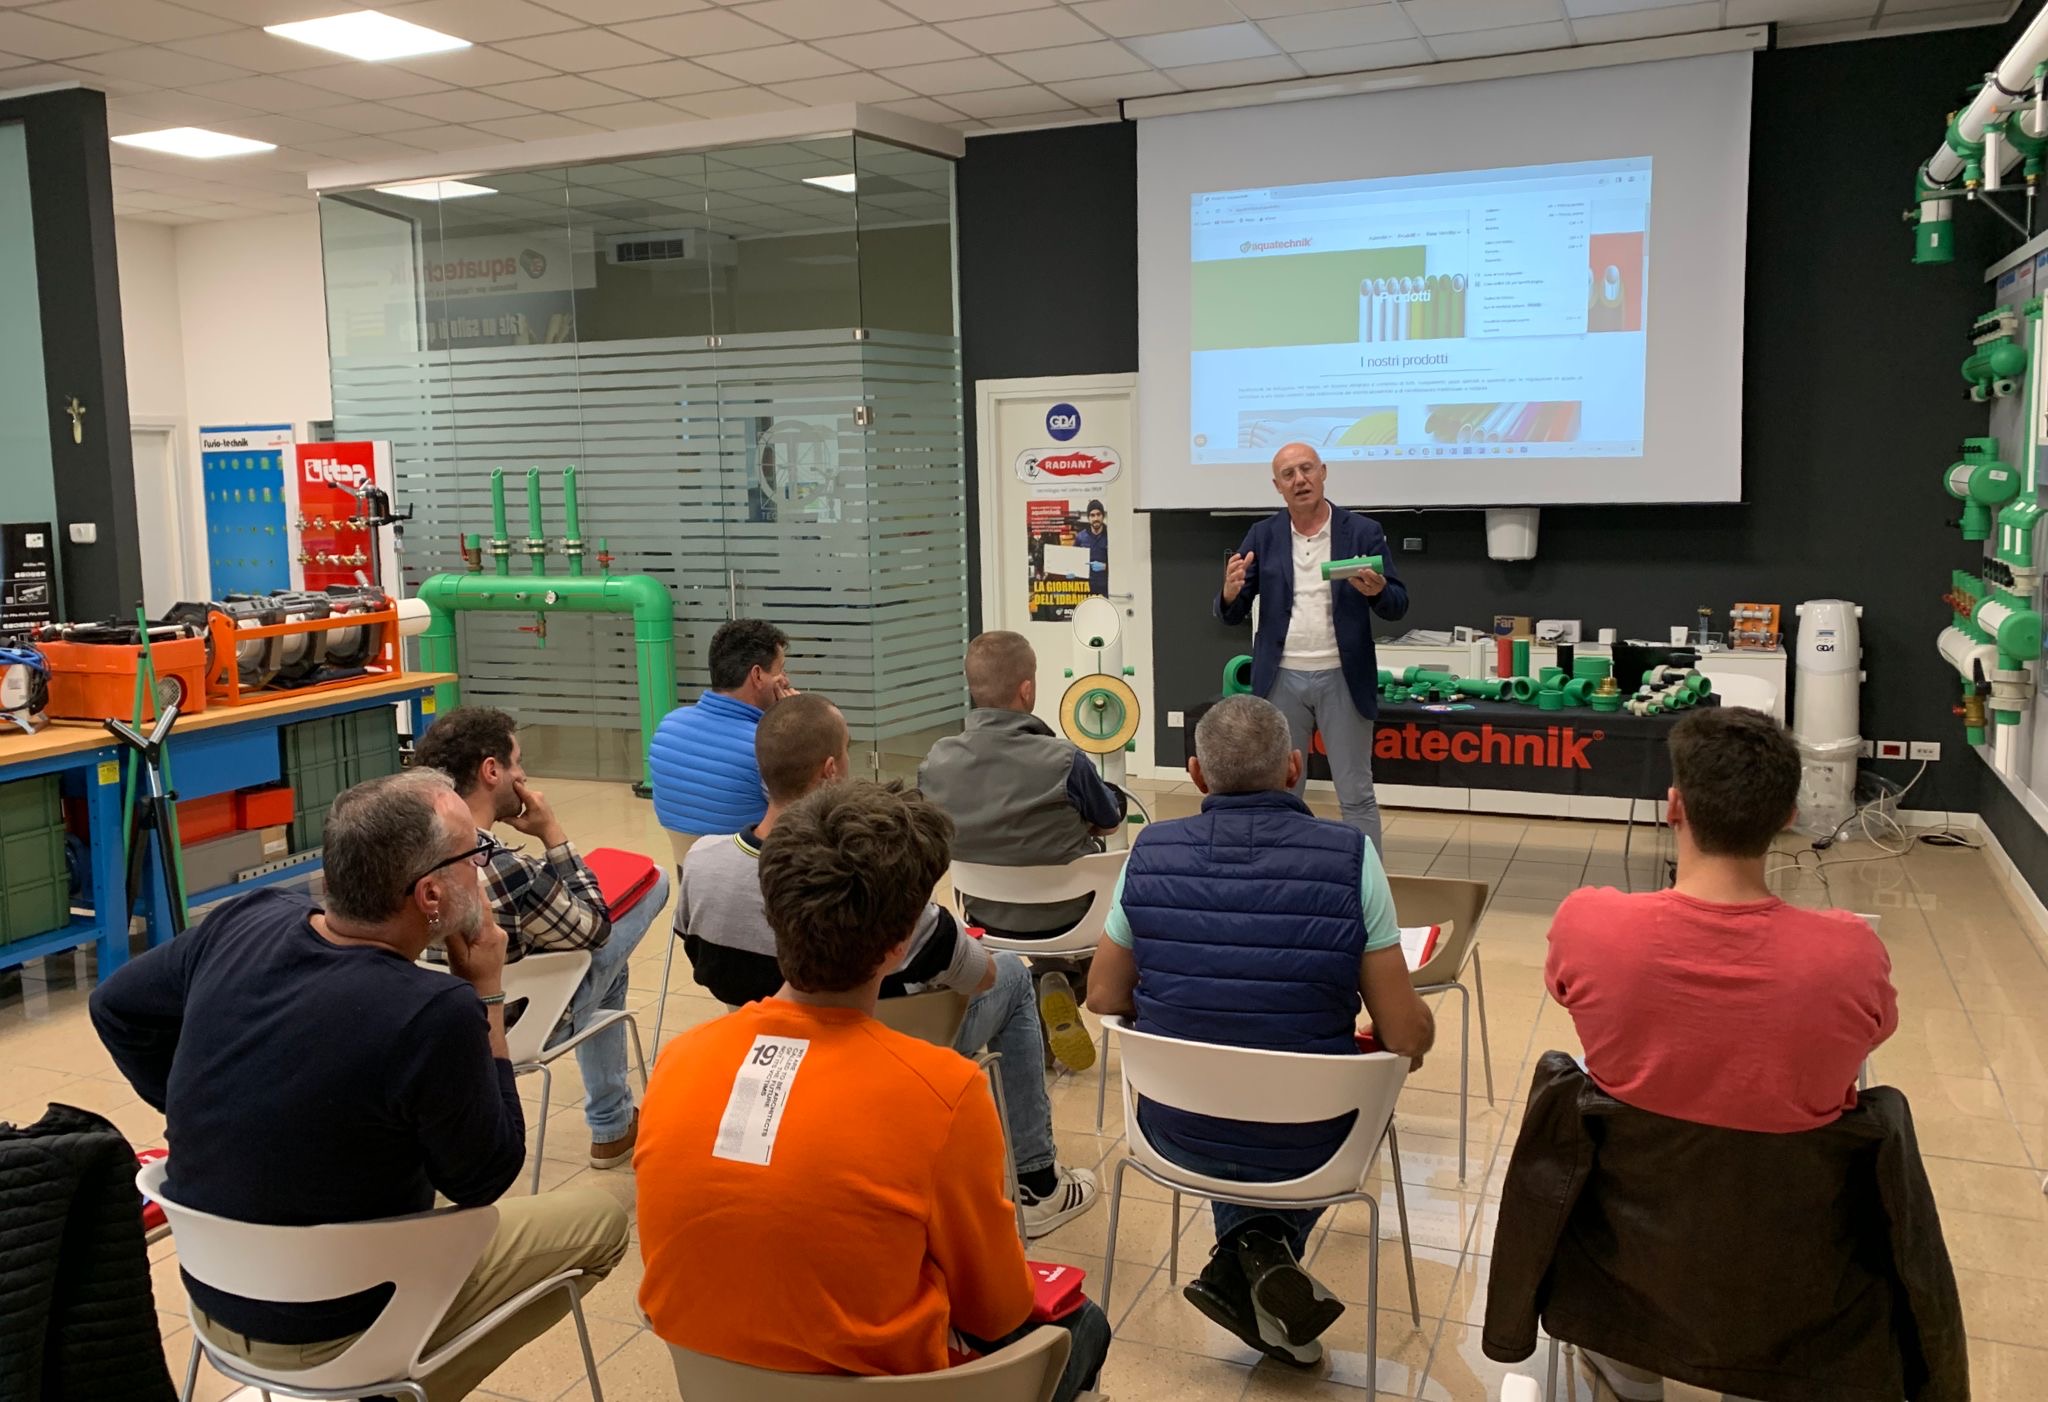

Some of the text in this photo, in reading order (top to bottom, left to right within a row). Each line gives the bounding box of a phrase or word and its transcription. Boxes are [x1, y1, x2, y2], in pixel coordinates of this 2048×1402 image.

[1367, 355, 1399, 368] nostri
[1402, 353, 1449, 369] prodotti
[1044, 460, 1093, 470] RADIANT
[1033, 580, 1091, 593] LA GIORNATA
[1033, 593, 1104, 606] DELL'IDRAU
[1308, 723, 1592, 770] atechnik
[752, 1044, 778, 1066] 19
[783, 1047, 798, 1071] CALLED
[773, 1066, 781, 1079] THE
[779, 1072, 787, 1081] TO
[760, 1069, 774, 1097] VICTIMS
[764, 1080, 776, 1108] FUTURE
[761, 1092, 778, 1138] ARCHITECTS
